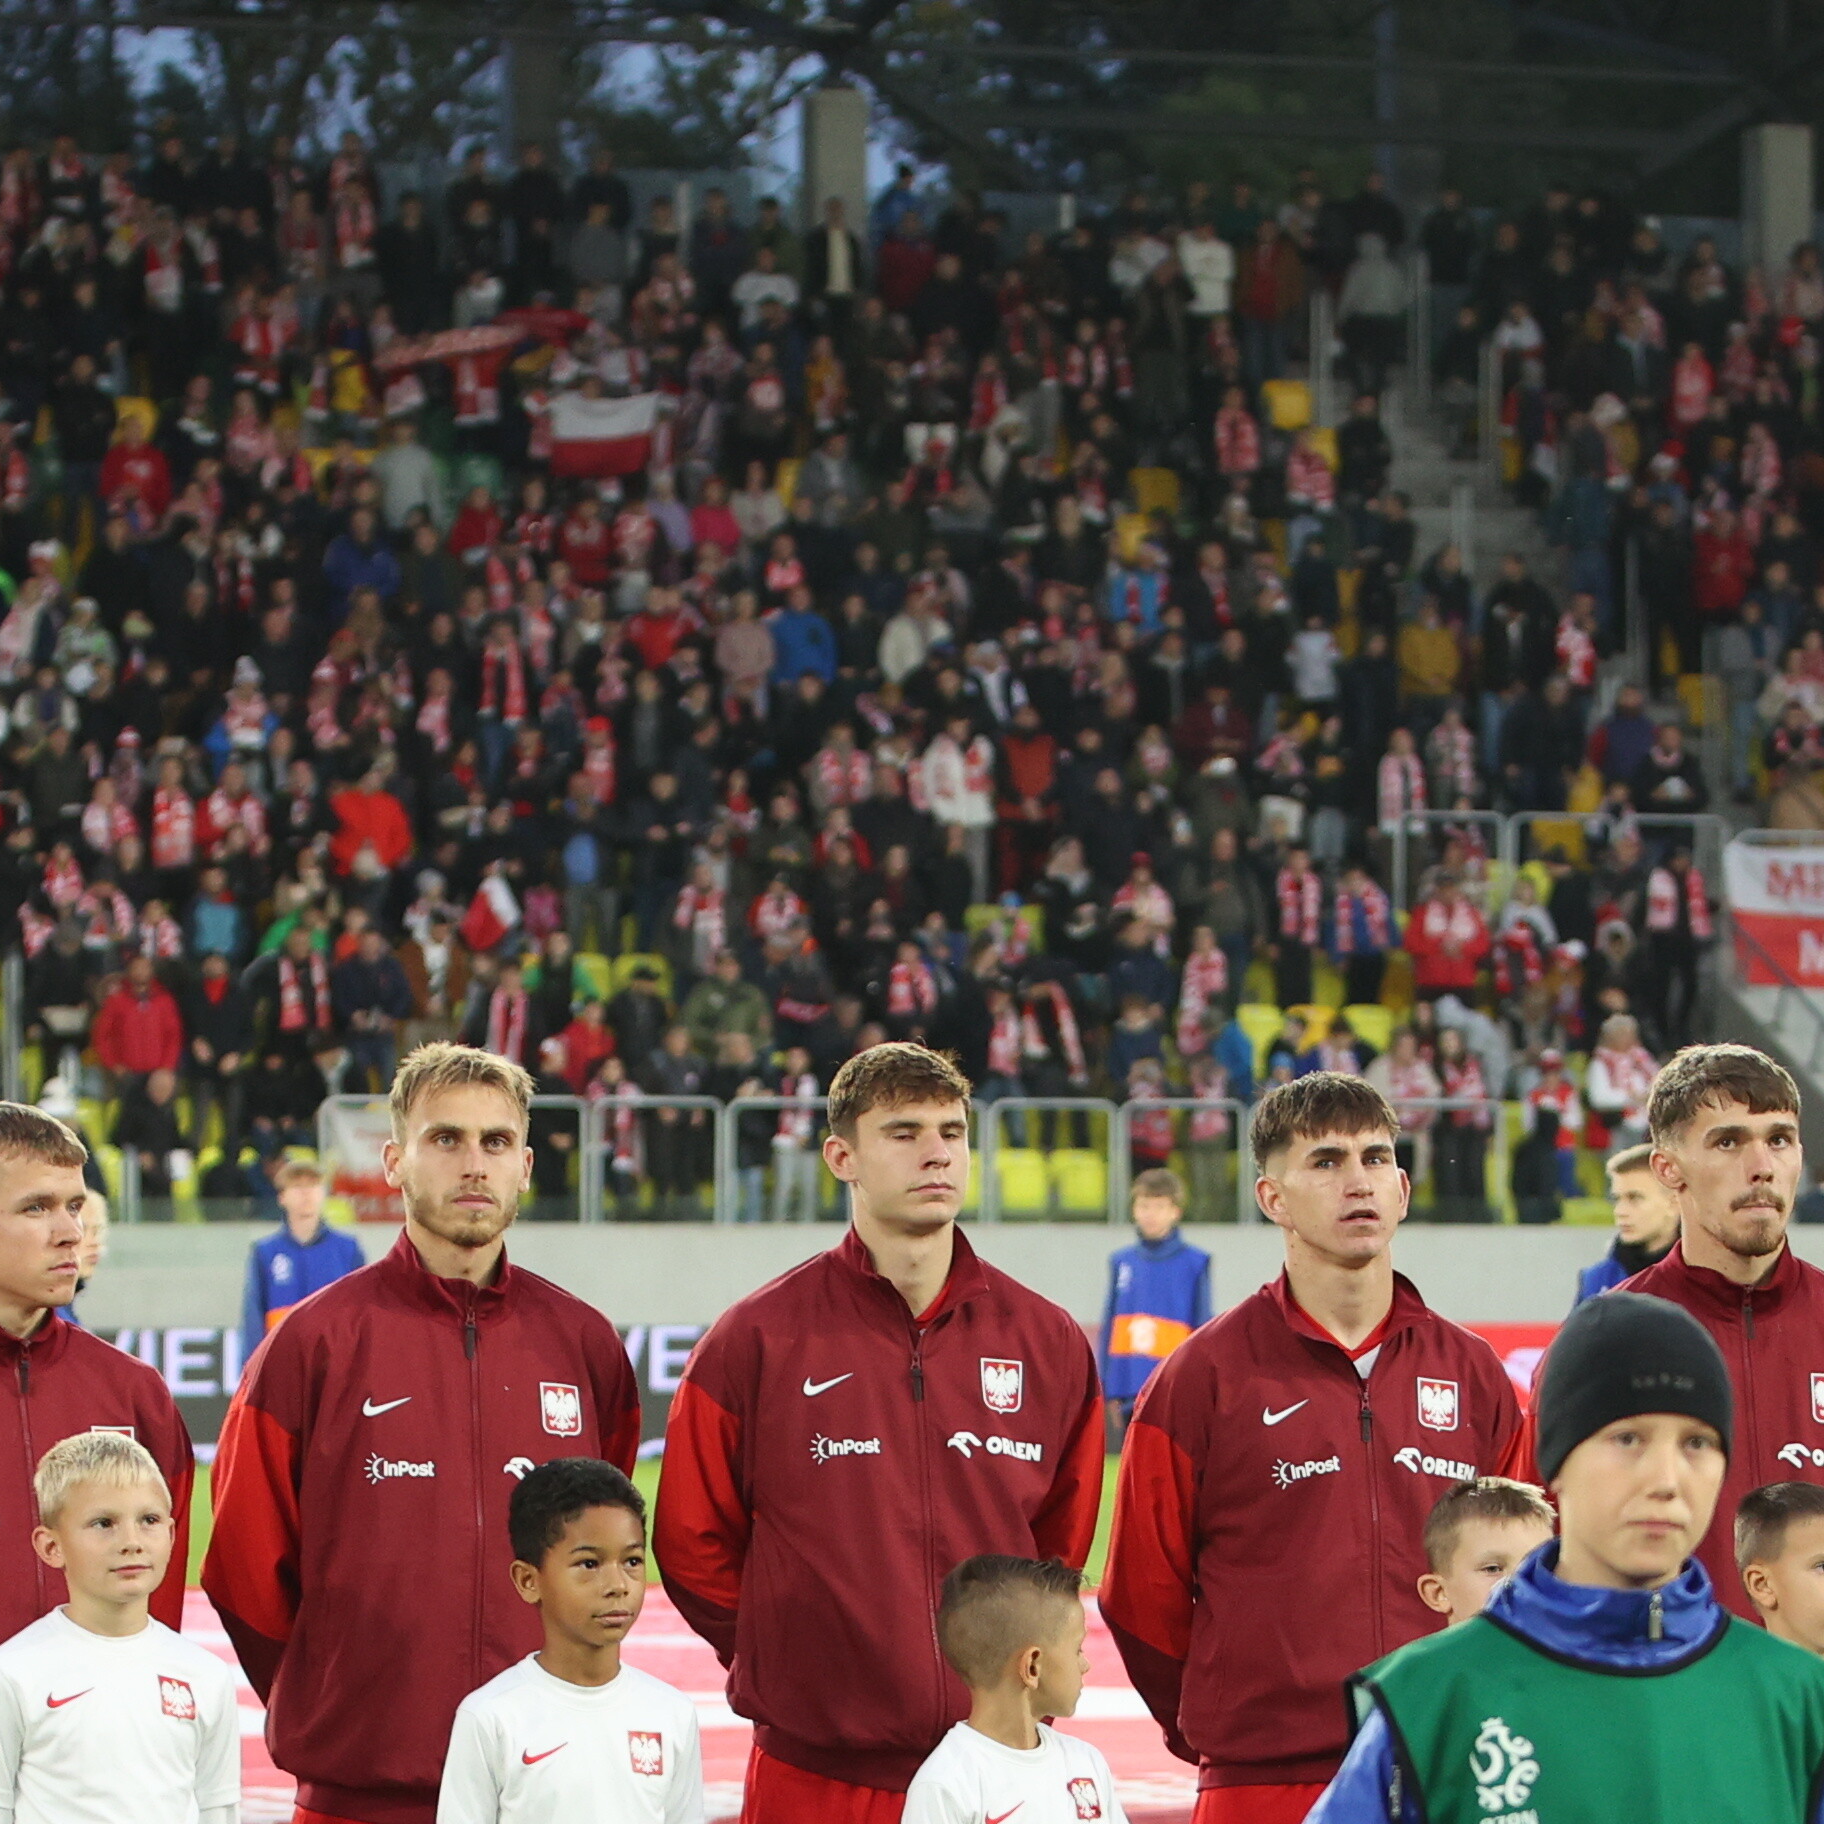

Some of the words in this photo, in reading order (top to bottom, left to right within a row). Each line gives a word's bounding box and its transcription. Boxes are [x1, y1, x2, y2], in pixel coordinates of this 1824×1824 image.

[828, 1437, 881, 1456] InPost
[986, 1436, 1042, 1462] ORLEN
[383, 1461, 435, 1477] InPost
[1291, 1455, 1341, 1479] InPost
[1421, 1456, 1476, 1481] ORLEN
